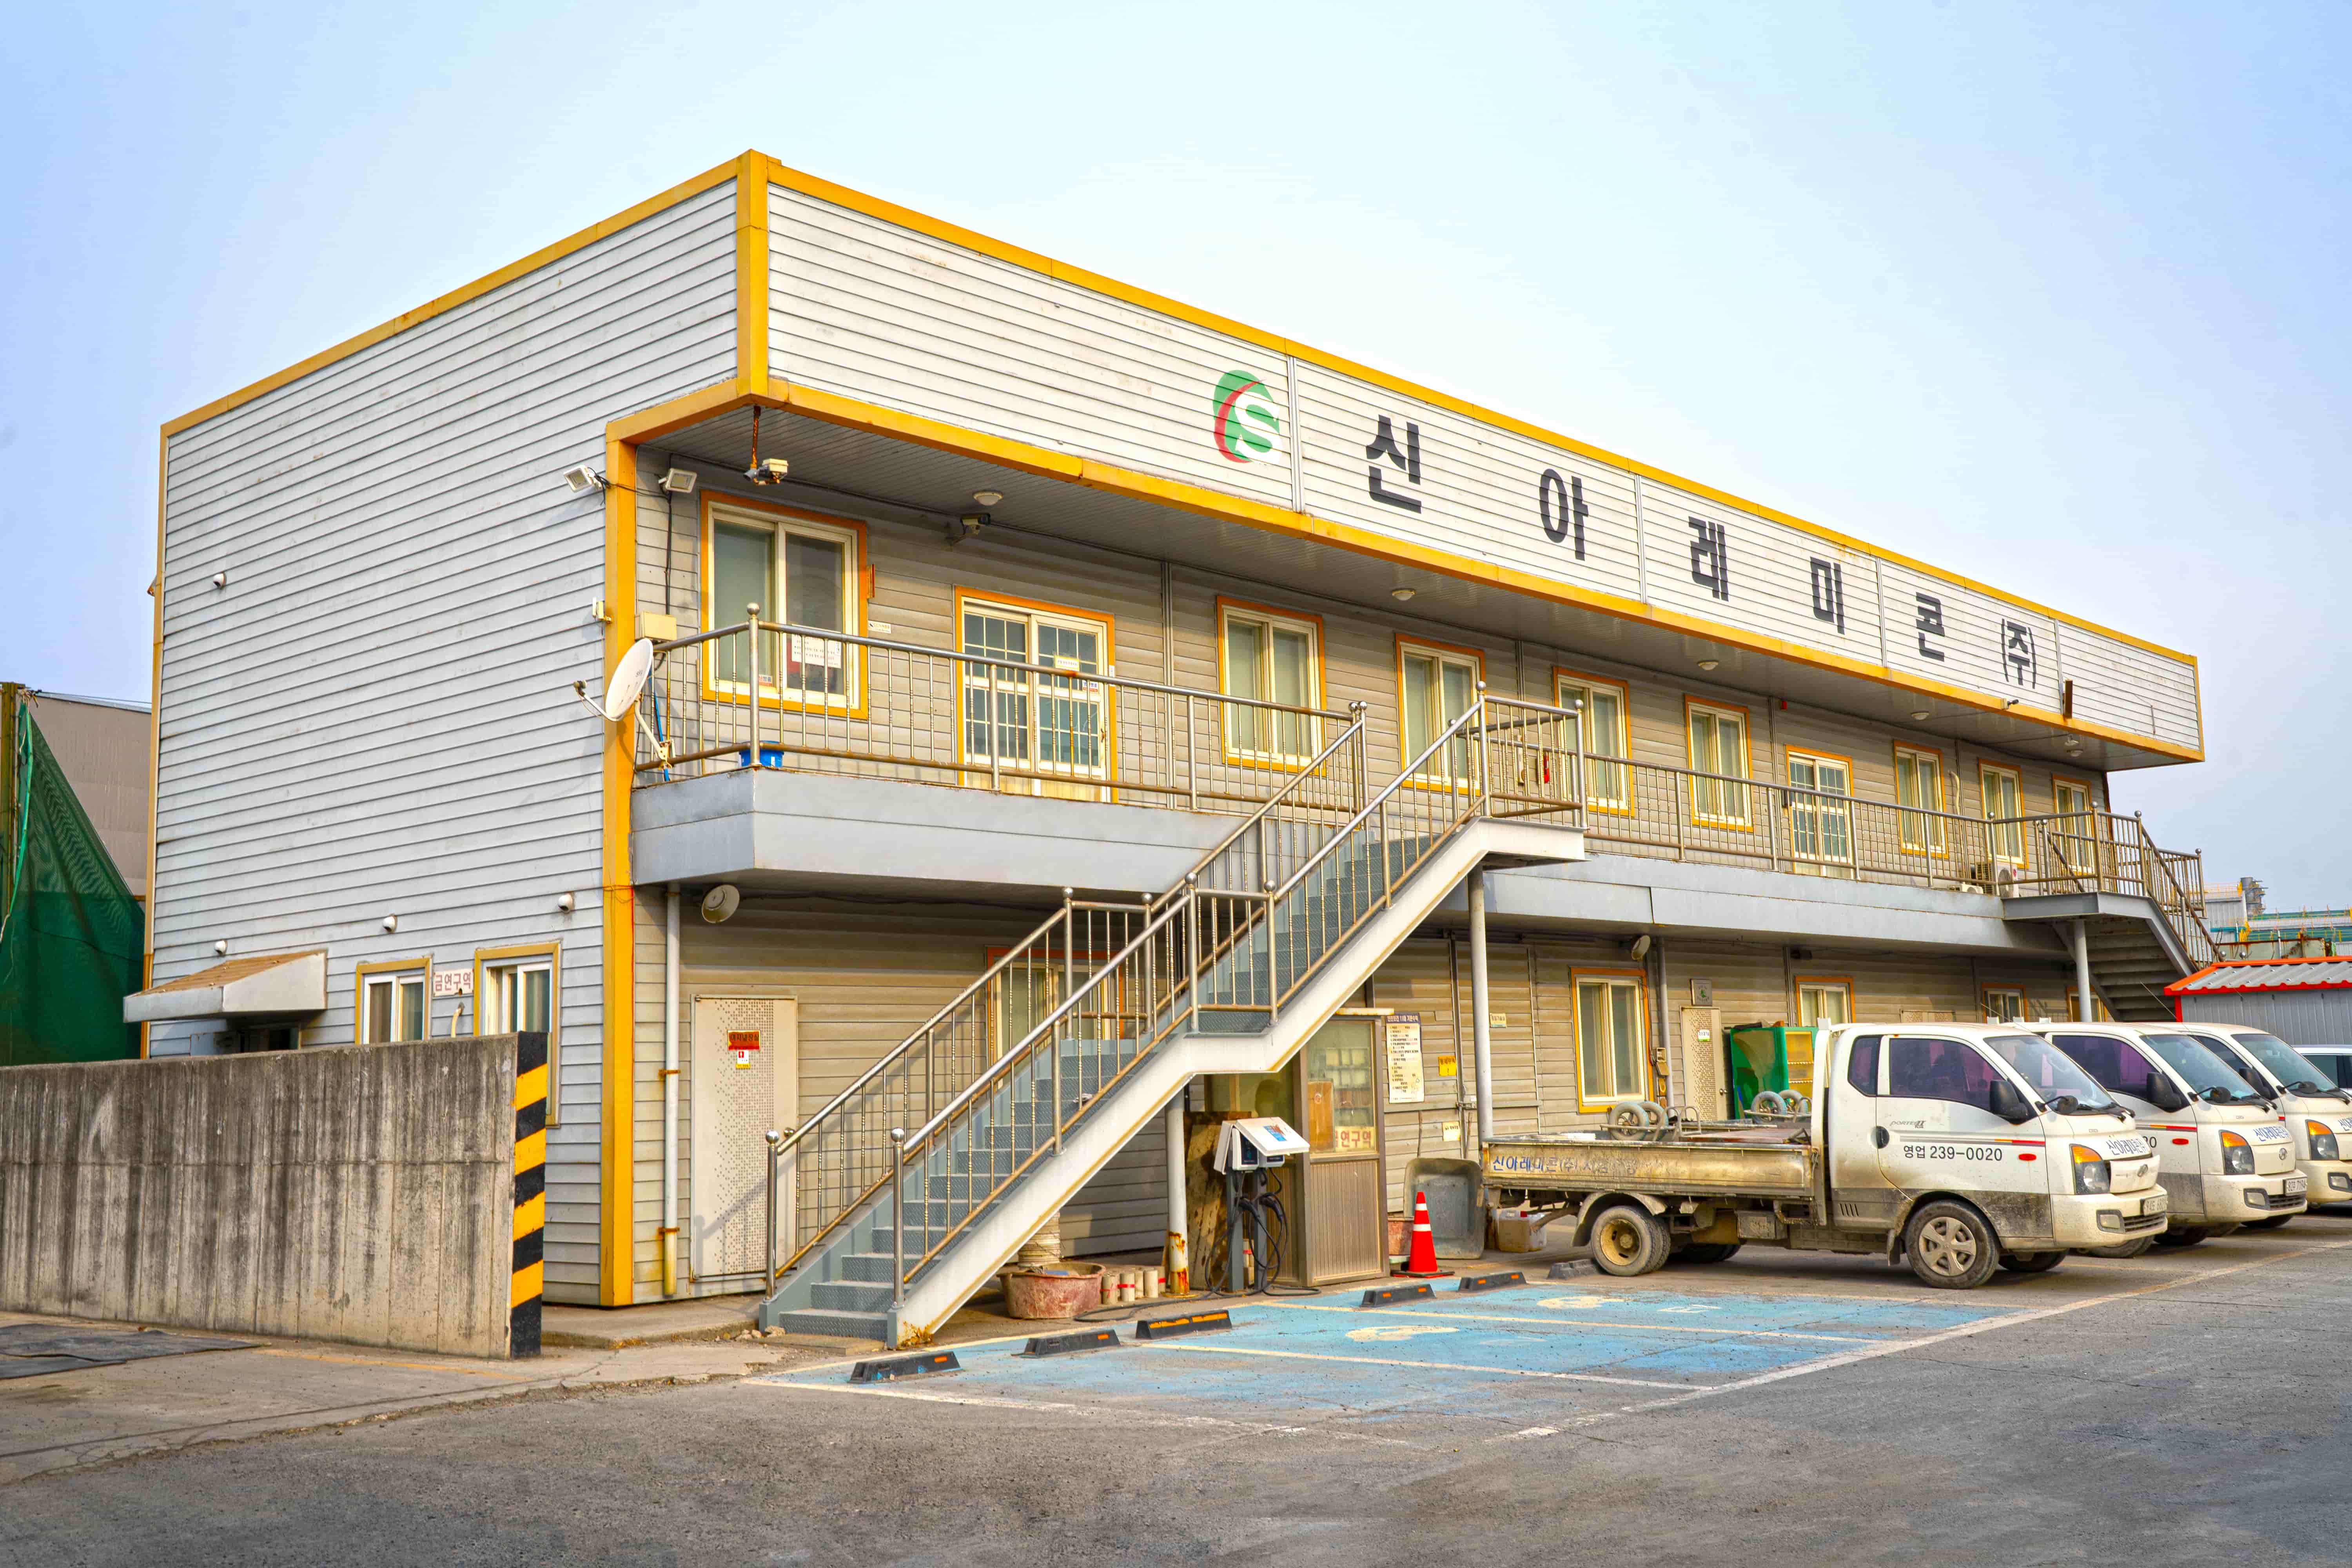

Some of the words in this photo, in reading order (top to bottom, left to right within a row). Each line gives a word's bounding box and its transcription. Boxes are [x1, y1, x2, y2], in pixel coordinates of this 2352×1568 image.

[435, 972, 471, 991] 금연구역
[1904, 1145, 1926, 1159] 영업
[1930, 1145, 2003, 1161] 239-0020
[1493, 1155, 1577, 1172] 신아레미콘(주)
